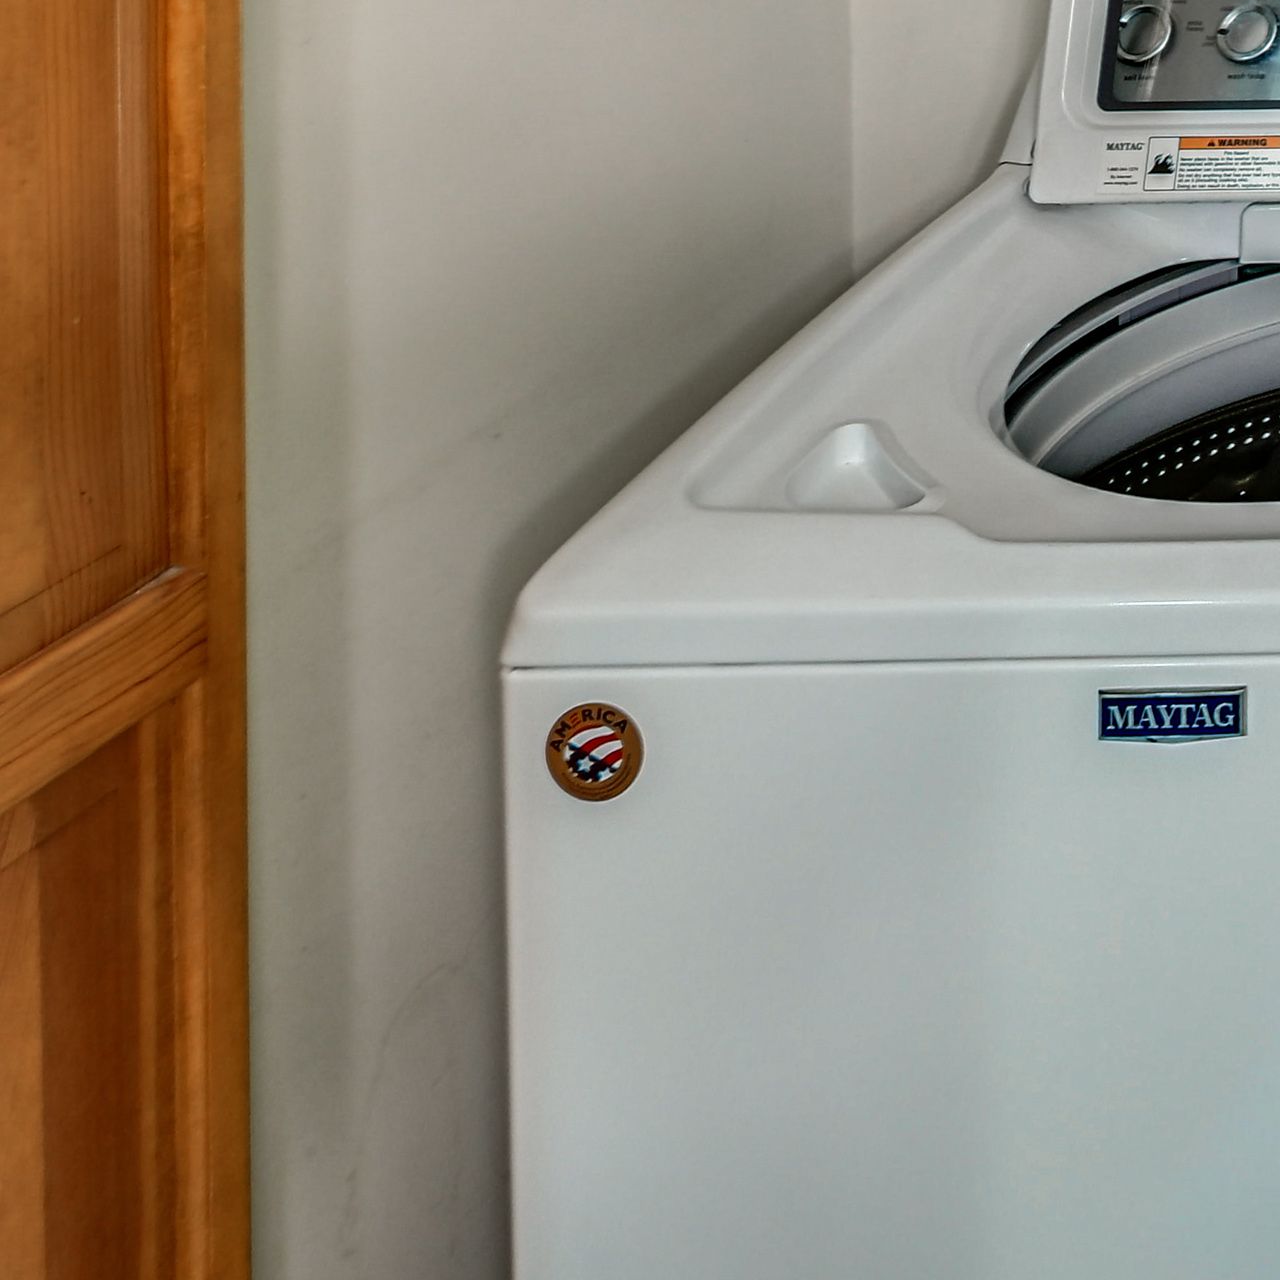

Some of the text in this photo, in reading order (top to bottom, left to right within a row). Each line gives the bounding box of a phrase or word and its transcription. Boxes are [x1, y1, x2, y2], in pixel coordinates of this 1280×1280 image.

[1106, 142, 1142, 151] MAYTAG
[1217, 138, 1268, 147] WARNING
[1106, 701, 1235, 730] MAYTAG
[550, 708, 628, 753] AMERICA
